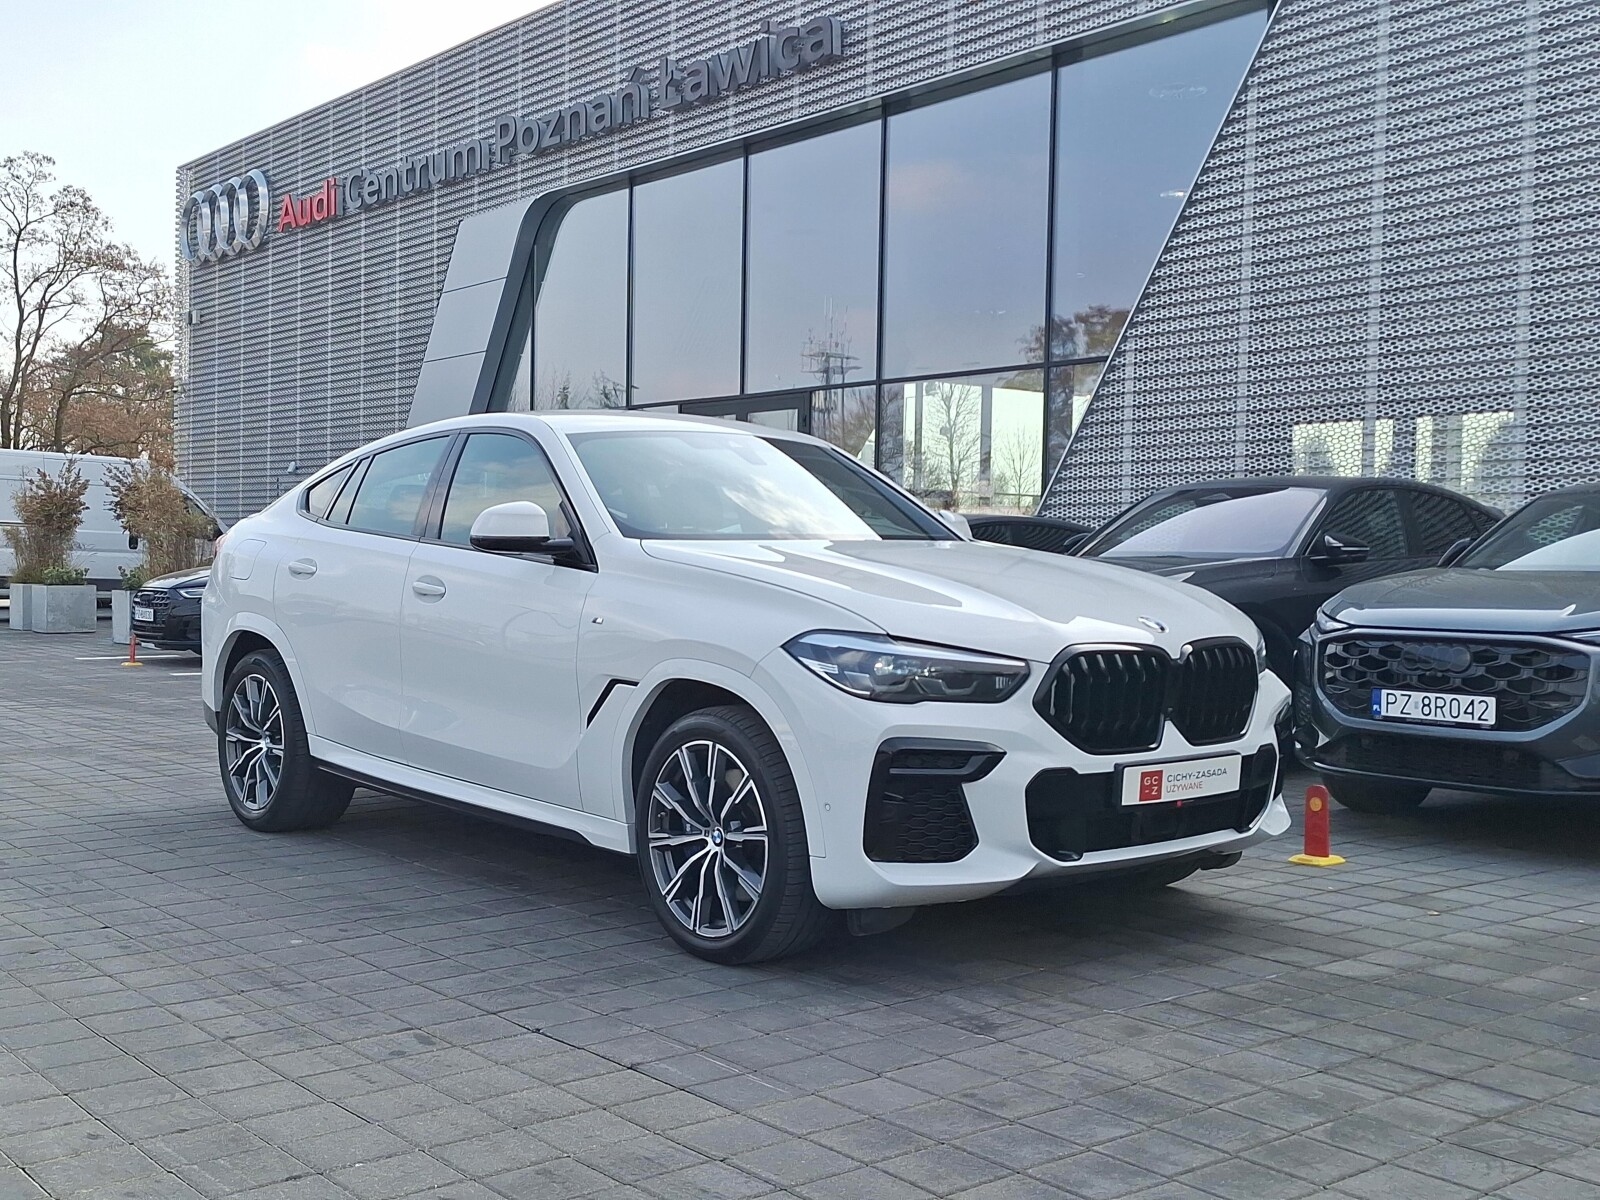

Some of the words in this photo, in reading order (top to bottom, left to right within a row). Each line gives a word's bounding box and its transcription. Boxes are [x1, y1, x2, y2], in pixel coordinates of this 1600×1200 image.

[277, 175, 342, 232] Audi
[345, 138, 489, 210] Centrum
[495, 66, 650, 163] Poznań
[659, 15, 842, 111] Ławica
[1385, 692, 1412, 716] PZ
[1421, 695, 1489, 722] 8R042
[1144, 776, 1159, 786] GC
[1166, 768, 1228, 783] CICHY-ZASADA
[1166, 781, 1203, 793] UŻYWANE
